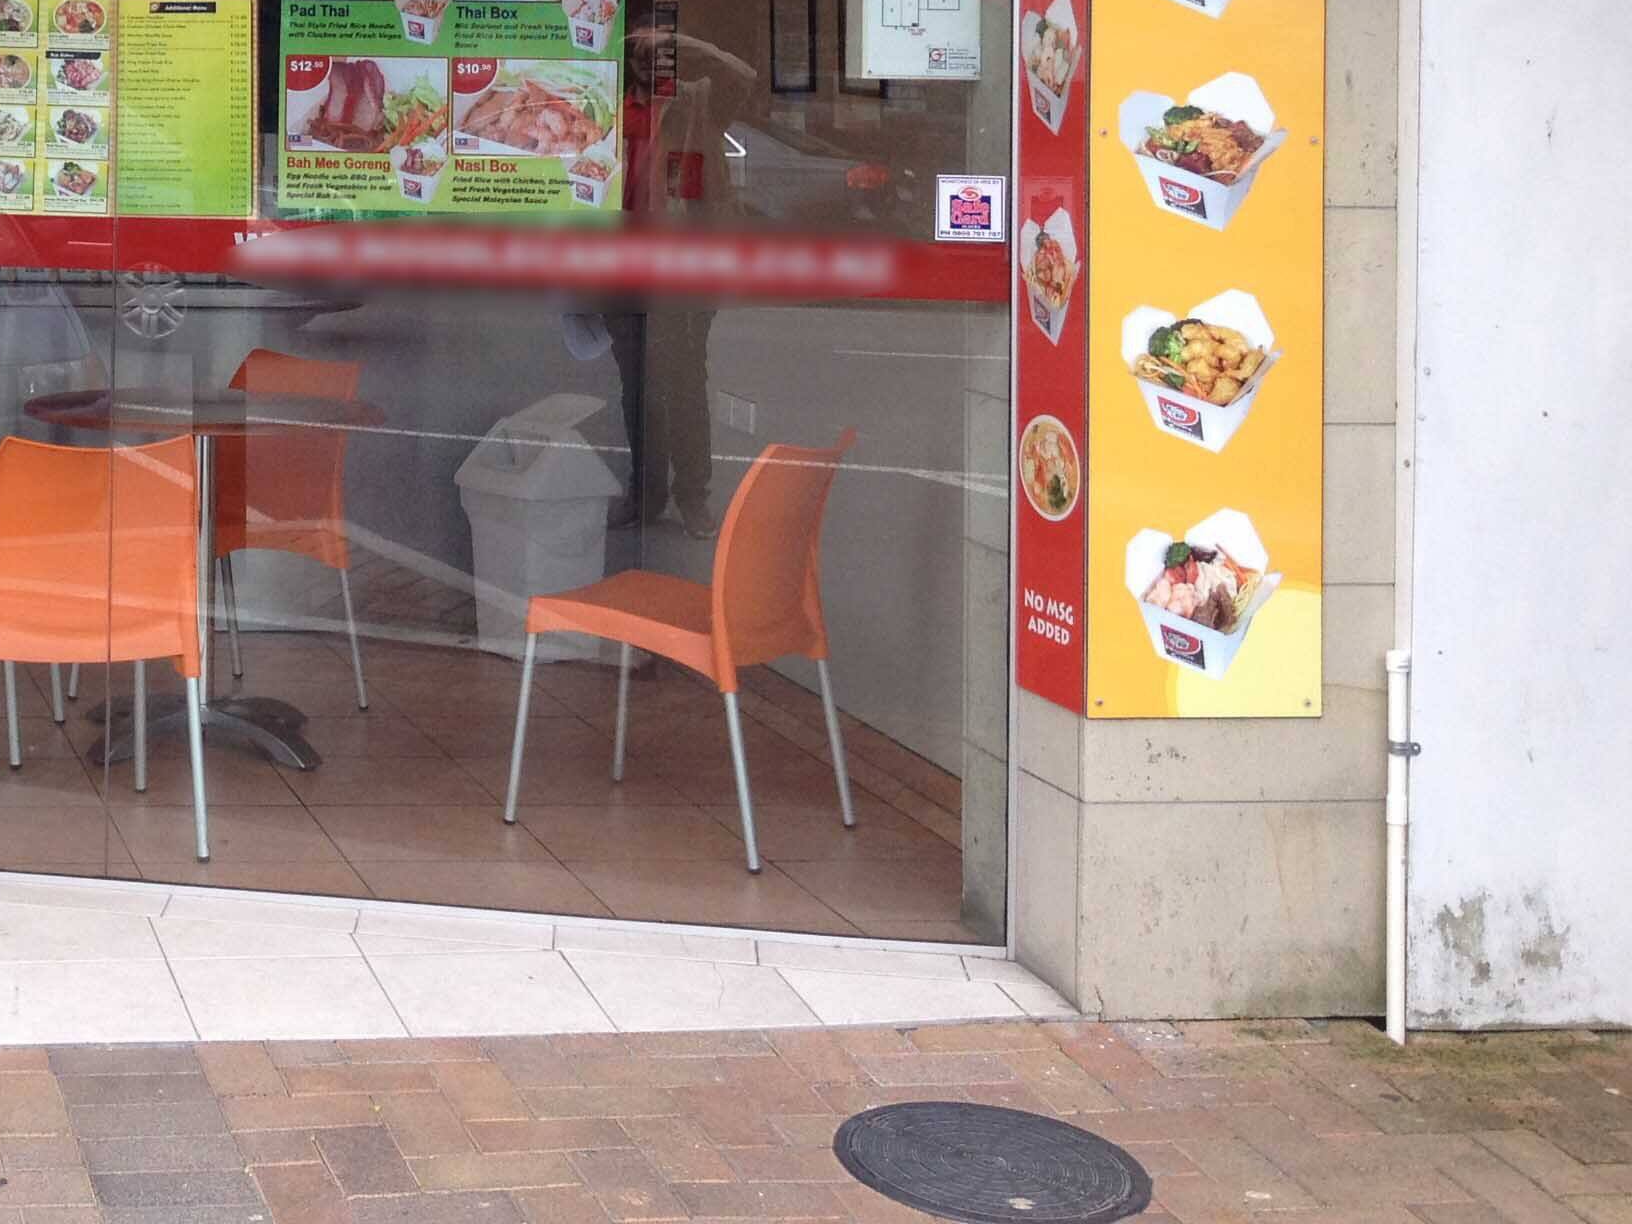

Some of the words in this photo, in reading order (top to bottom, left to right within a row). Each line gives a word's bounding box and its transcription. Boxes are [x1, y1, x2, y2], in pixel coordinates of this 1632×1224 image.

[289, 4, 316, 17] Pad
[321, 4, 350, 17] Thai
[456, 6, 486, 19] Thai
[490, 7, 518, 20] Box
[287, 156, 311, 169] Bah
[315, 157, 341, 169] Mee
[344, 158, 391, 173] Goreng
[454, 159, 485, 172] Nasi
[490, 159, 518, 173] Box
[1024, 586, 1044, 613] NO
[1046, 596, 1074, 626] MSG
[1028, 615, 1070, 646] ADDED
